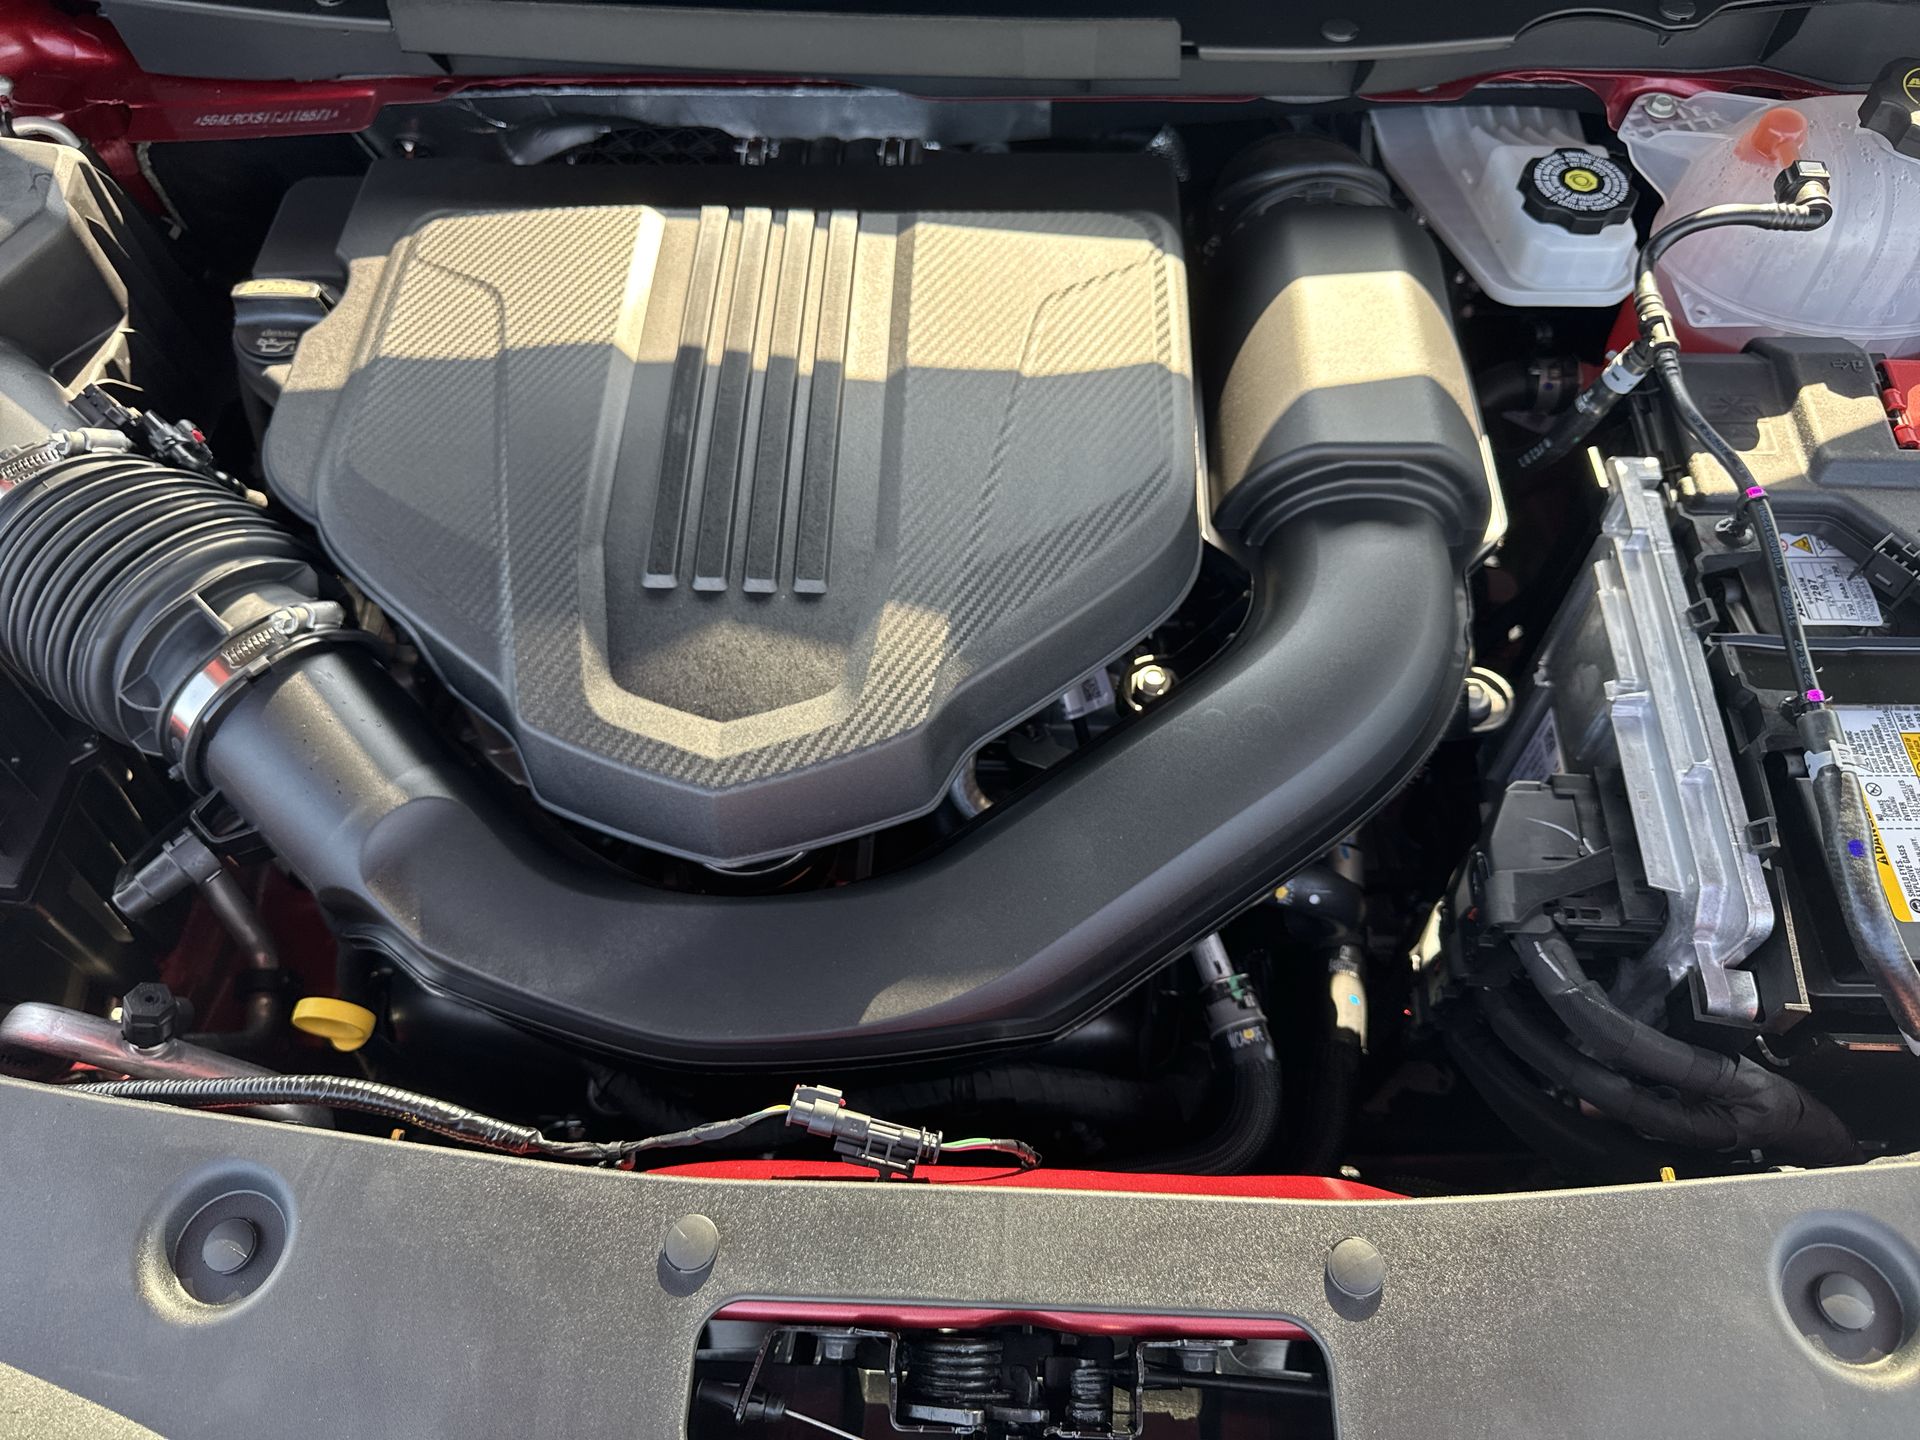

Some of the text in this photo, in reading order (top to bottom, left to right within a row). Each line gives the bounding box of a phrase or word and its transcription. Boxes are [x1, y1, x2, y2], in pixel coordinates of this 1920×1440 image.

[1807, 578, 1824, 602] 7287
[1895, 712, 1904, 722] NOT
[1854, 732, 1867, 755] ACID CAN
[1860, 730, 1882, 772] CAUSE BLINDNESS
[1872, 724, 1897, 772] L'ACIDE SULFURIQUE
[1888, 740, 1900, 759] CAUSER
[1874, 747, 1886, 764] SEVERE
[1901, 756, 1910, 764] DES
[1896, 761, 1906, 772] PEUT
[1907, 784, 1920, 807] FLAMMES
[1877, 800, 1888, 817] SPARKS
[1884, 799, 1895, 817] FLAMES
[1888, 796, 1902, 817] SMOKING
[1910, 809, 1918, 817] LES
[1897, 845, 1910, 863] GASES
[1903, 876, 1916, 896] SHIELD
[1907, 865, 1920, 896] EXPLOSIVE
